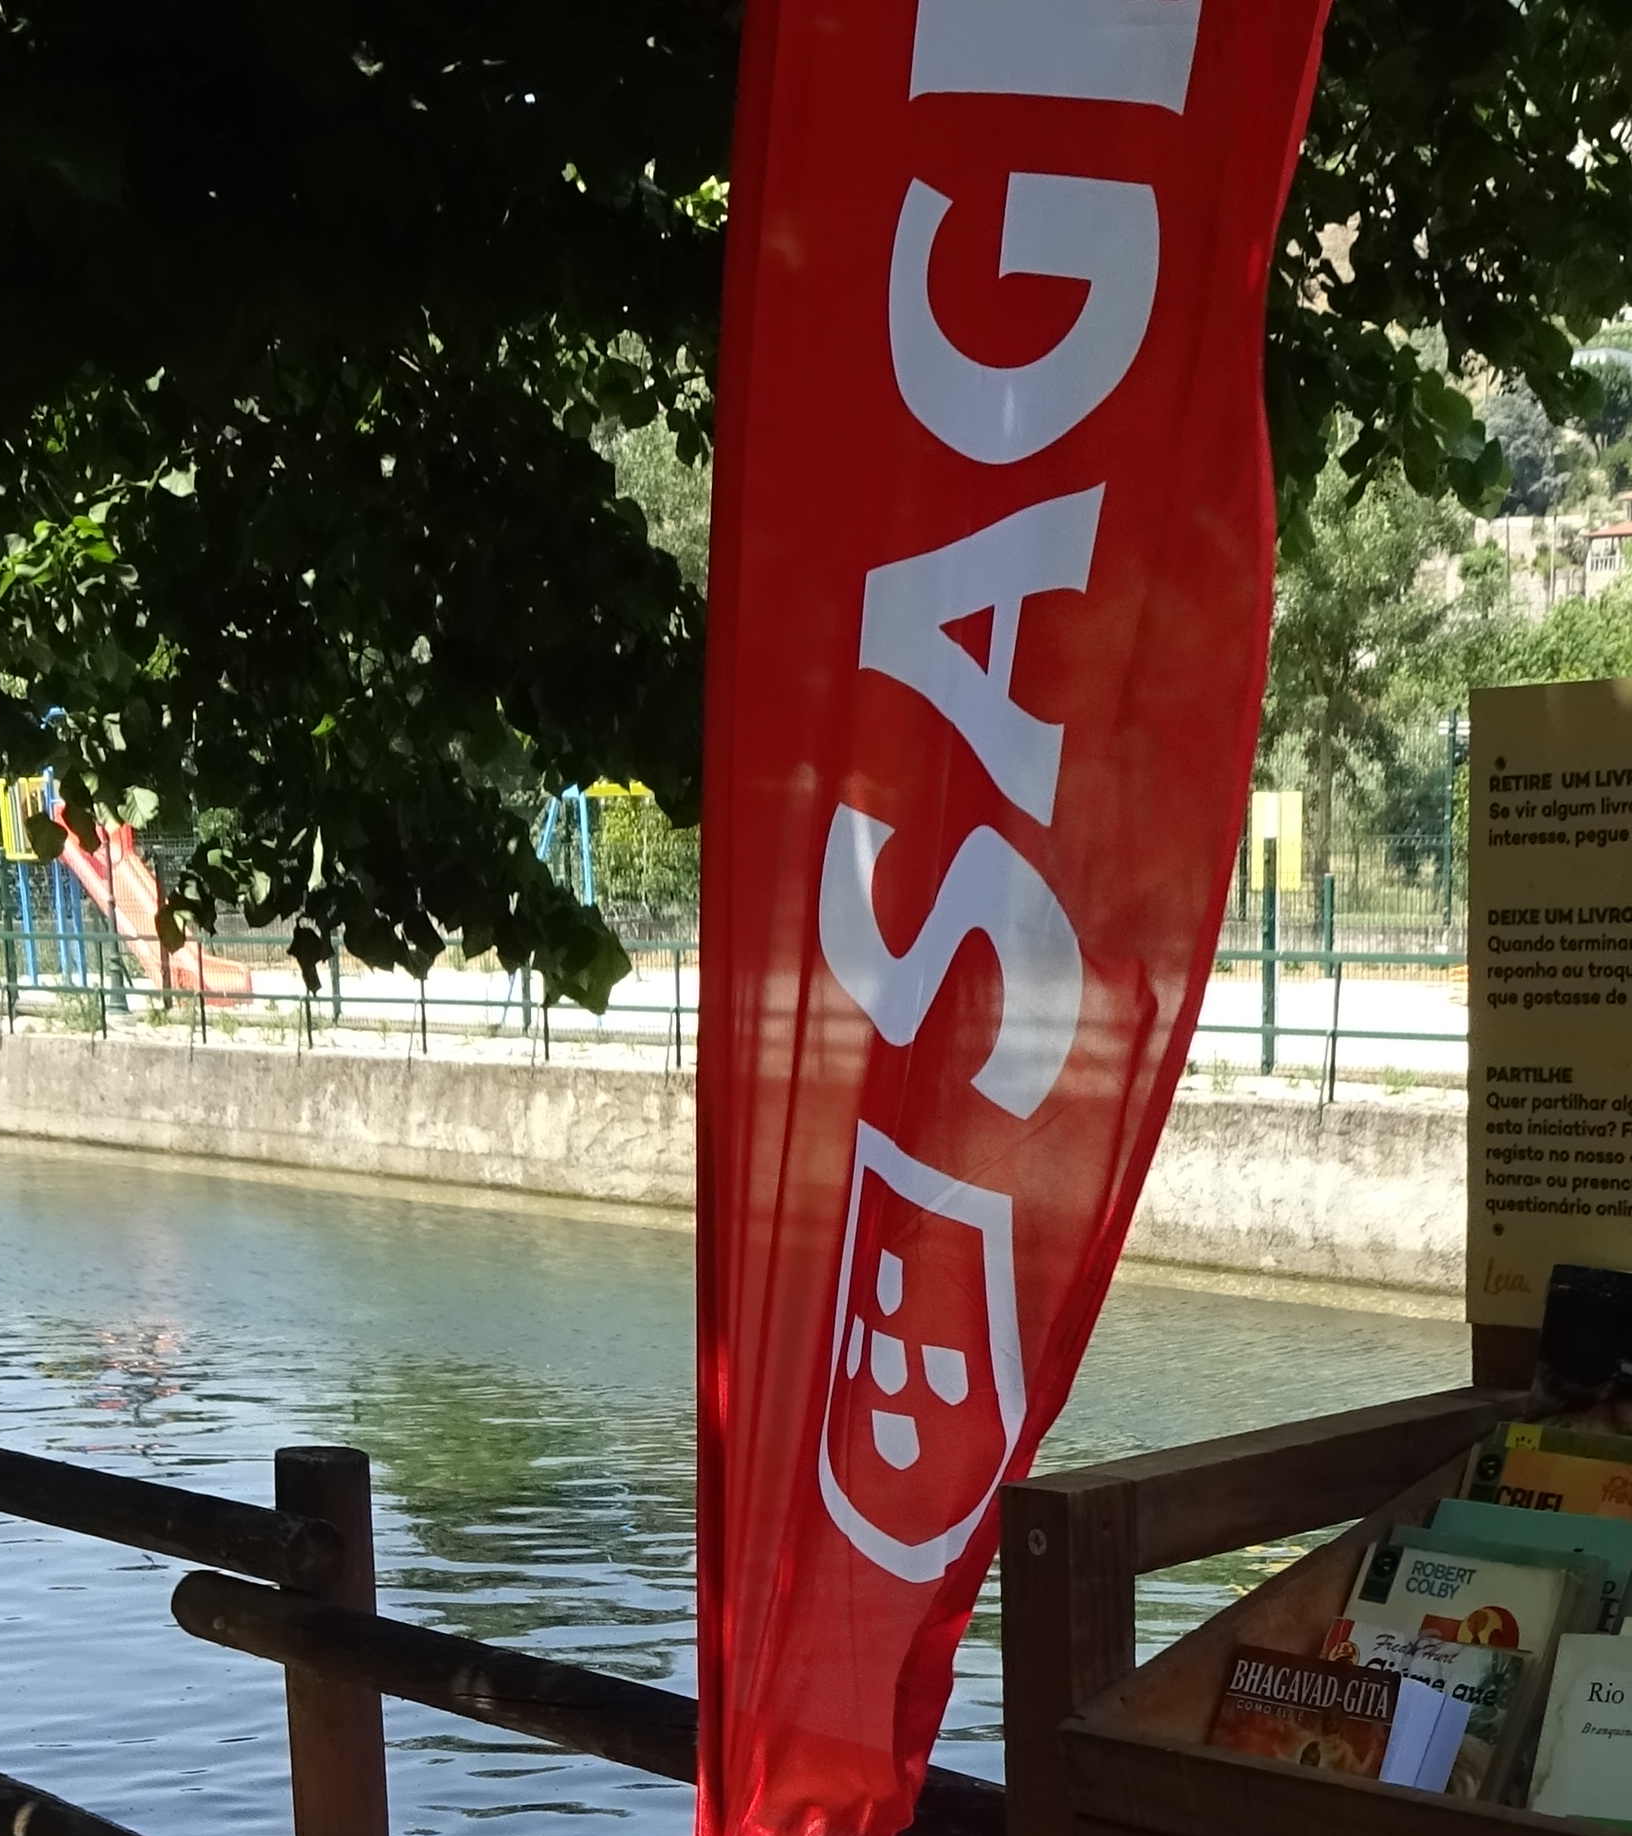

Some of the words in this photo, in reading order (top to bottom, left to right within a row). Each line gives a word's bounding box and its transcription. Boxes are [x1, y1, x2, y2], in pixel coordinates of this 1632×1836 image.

[1489, 772, 1552, 792] RETIRE
[1561, 771, 1590, 789] UM
[1489, 802, 1509, 820] Se
[1514, 801, 1536, 819] vir
[1541, 798, 1595, 823] algum
[1488, 825, 1570, 847] interesse,
[1574, 825, 1629, 849] pegue
[1488, 907, 1539, 926] DEIXE
[1544, 907, 1573, 925] UM
[1487, 935, 1555, 955] Quando
[1487, 961, 1558, 984] reponha
[1561, 963, 1584, 978] ou
[1487, 990, 1519, 1010] que
[1522, 989, 1602, 1010] gostasse
[1606, 987, 1626, 1006] de
[1486, 1066, 1573, 1085] PARTILHE
[1485, 1091, 1526, 1113] Quer
[1530, 1093, 1607, 1117] partilhar
[1486, 1119, 1522, 1138] esta
[1527, 1118, 1616, 1140] iniciativa?
[1485, 1144, 1546, 1167] registo
[1549, 1150, 1570, 1165] no
[1573, 1150, 1624, 1167] nosso
[1485, 1169, 1542, 1190] honra»
[1546, 1174, 1567, 1190] ou
[1485, 1193, 1591, 1217] questionário
[1410, 1559, 1477, 1585] ROBERT
[1405, 1577, 1462, 1600] COLBY
[1588, 1681, 1625, 1705] Rio
[1235, 1699, 1271, 1715] COMO
